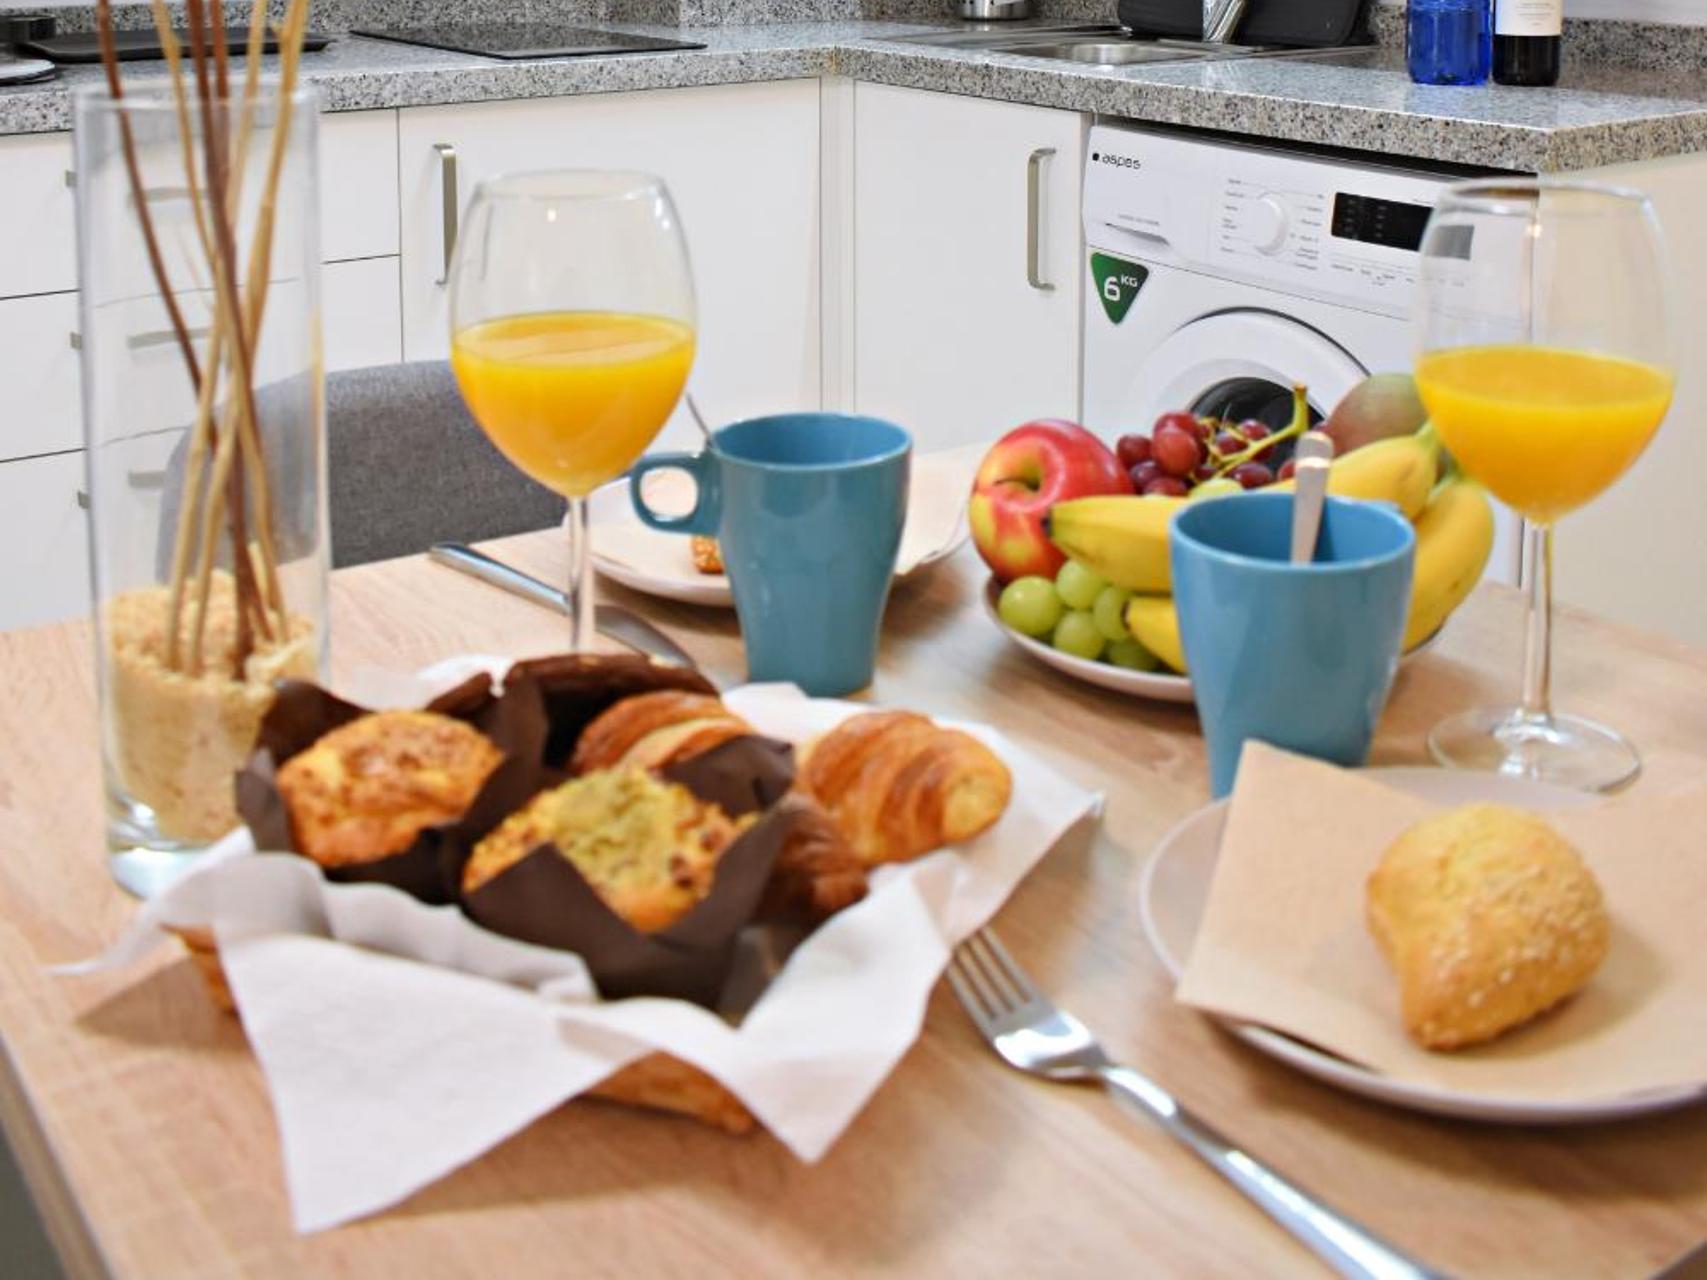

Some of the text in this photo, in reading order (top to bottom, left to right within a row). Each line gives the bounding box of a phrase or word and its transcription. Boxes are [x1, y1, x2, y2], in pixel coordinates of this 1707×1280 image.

[1102, 153, 1141, 170] aspes
[1104, 274, 1138, 302] 6 KG
